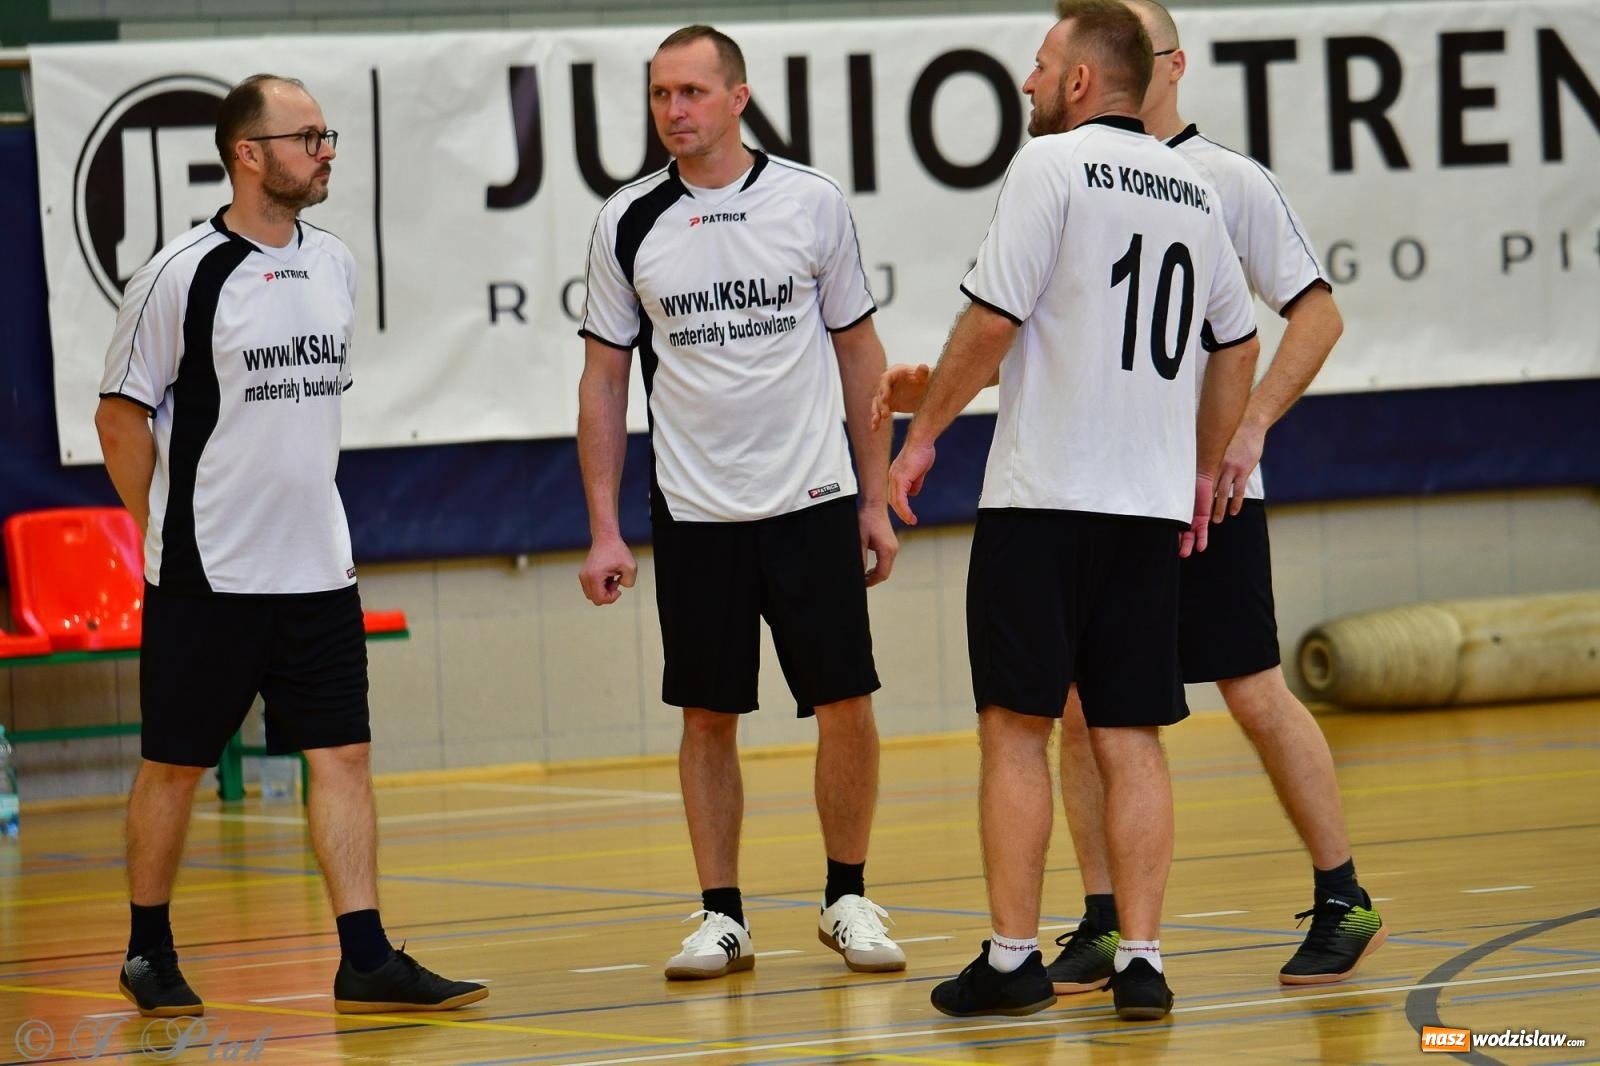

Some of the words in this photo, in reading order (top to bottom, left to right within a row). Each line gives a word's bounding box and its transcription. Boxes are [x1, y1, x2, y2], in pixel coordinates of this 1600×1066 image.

[1084, 163, 1114, 189] KS
[701, 212, 748, 224] PATRICK
[274, 269, 310, 280] PATRICK
[660, 275, 794, 318] www.IKSAL.pl
[1110, 233, 1195, 381] 10
[669, 321, 725, 347] materiały
[728, 314, 797, 340] budowlane
[243, 334, 347, 372] www.IKSAL.p
